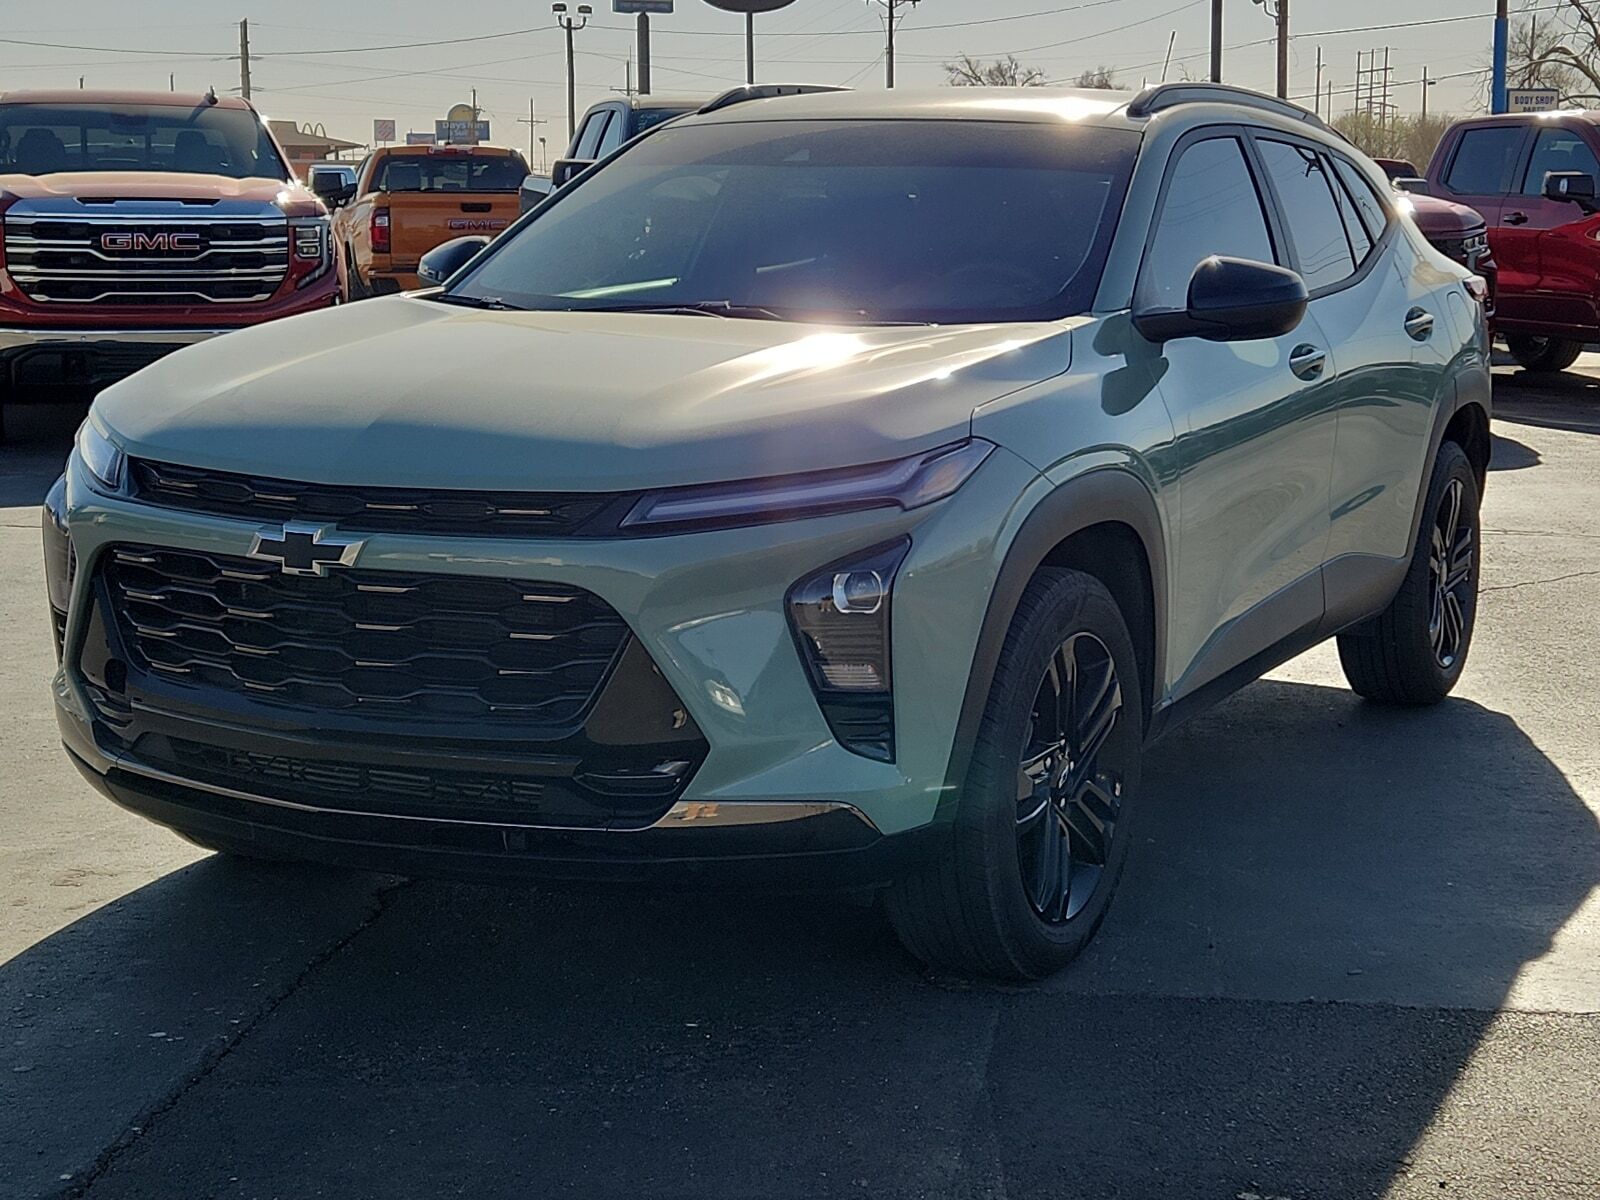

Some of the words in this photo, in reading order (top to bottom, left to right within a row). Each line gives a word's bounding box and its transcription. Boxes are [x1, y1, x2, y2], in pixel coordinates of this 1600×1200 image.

[1514, 95, 1534, 105] BODY
[1535, 95, 1554, 105] SHOP
[442, 122, 467, 130] Days
[447, 219, 506, 231] GMC
[101, 232, 200, 250] GMC
